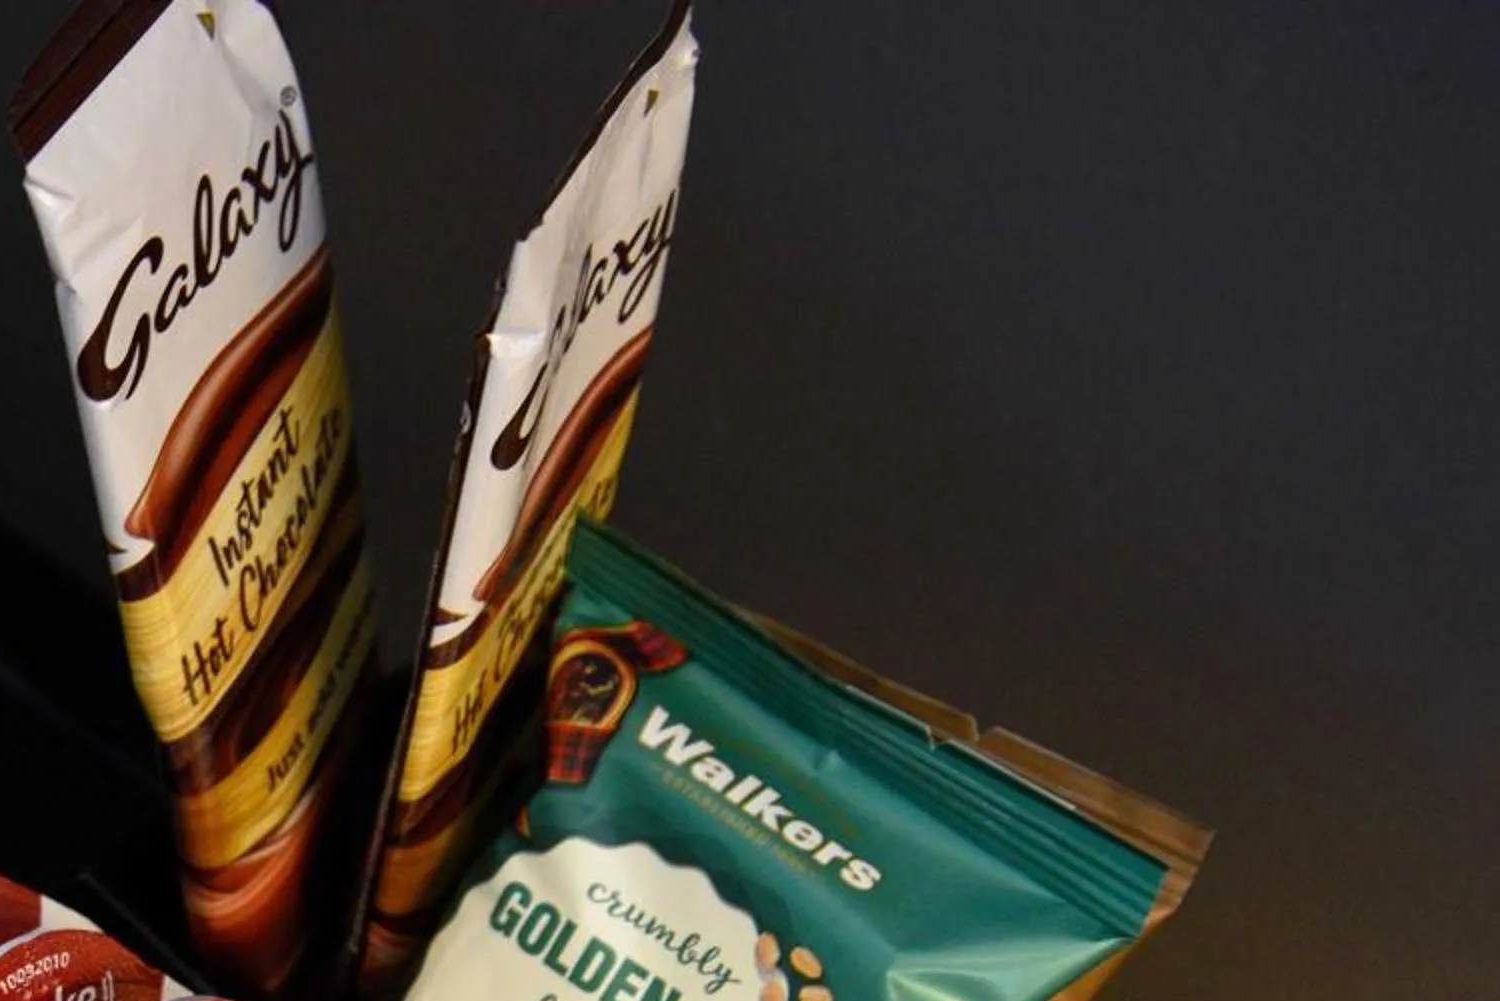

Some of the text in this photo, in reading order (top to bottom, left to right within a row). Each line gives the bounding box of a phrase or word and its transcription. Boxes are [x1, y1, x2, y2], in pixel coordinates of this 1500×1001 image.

[77, 109, 313, 402] Galaxy
[182, 408, 341, 706] Hot Chocolate
[208, 406, 299, 587] Instant
[638, 705, 882, 891] Walkers
[587, 882, 741, 995] crumbly
